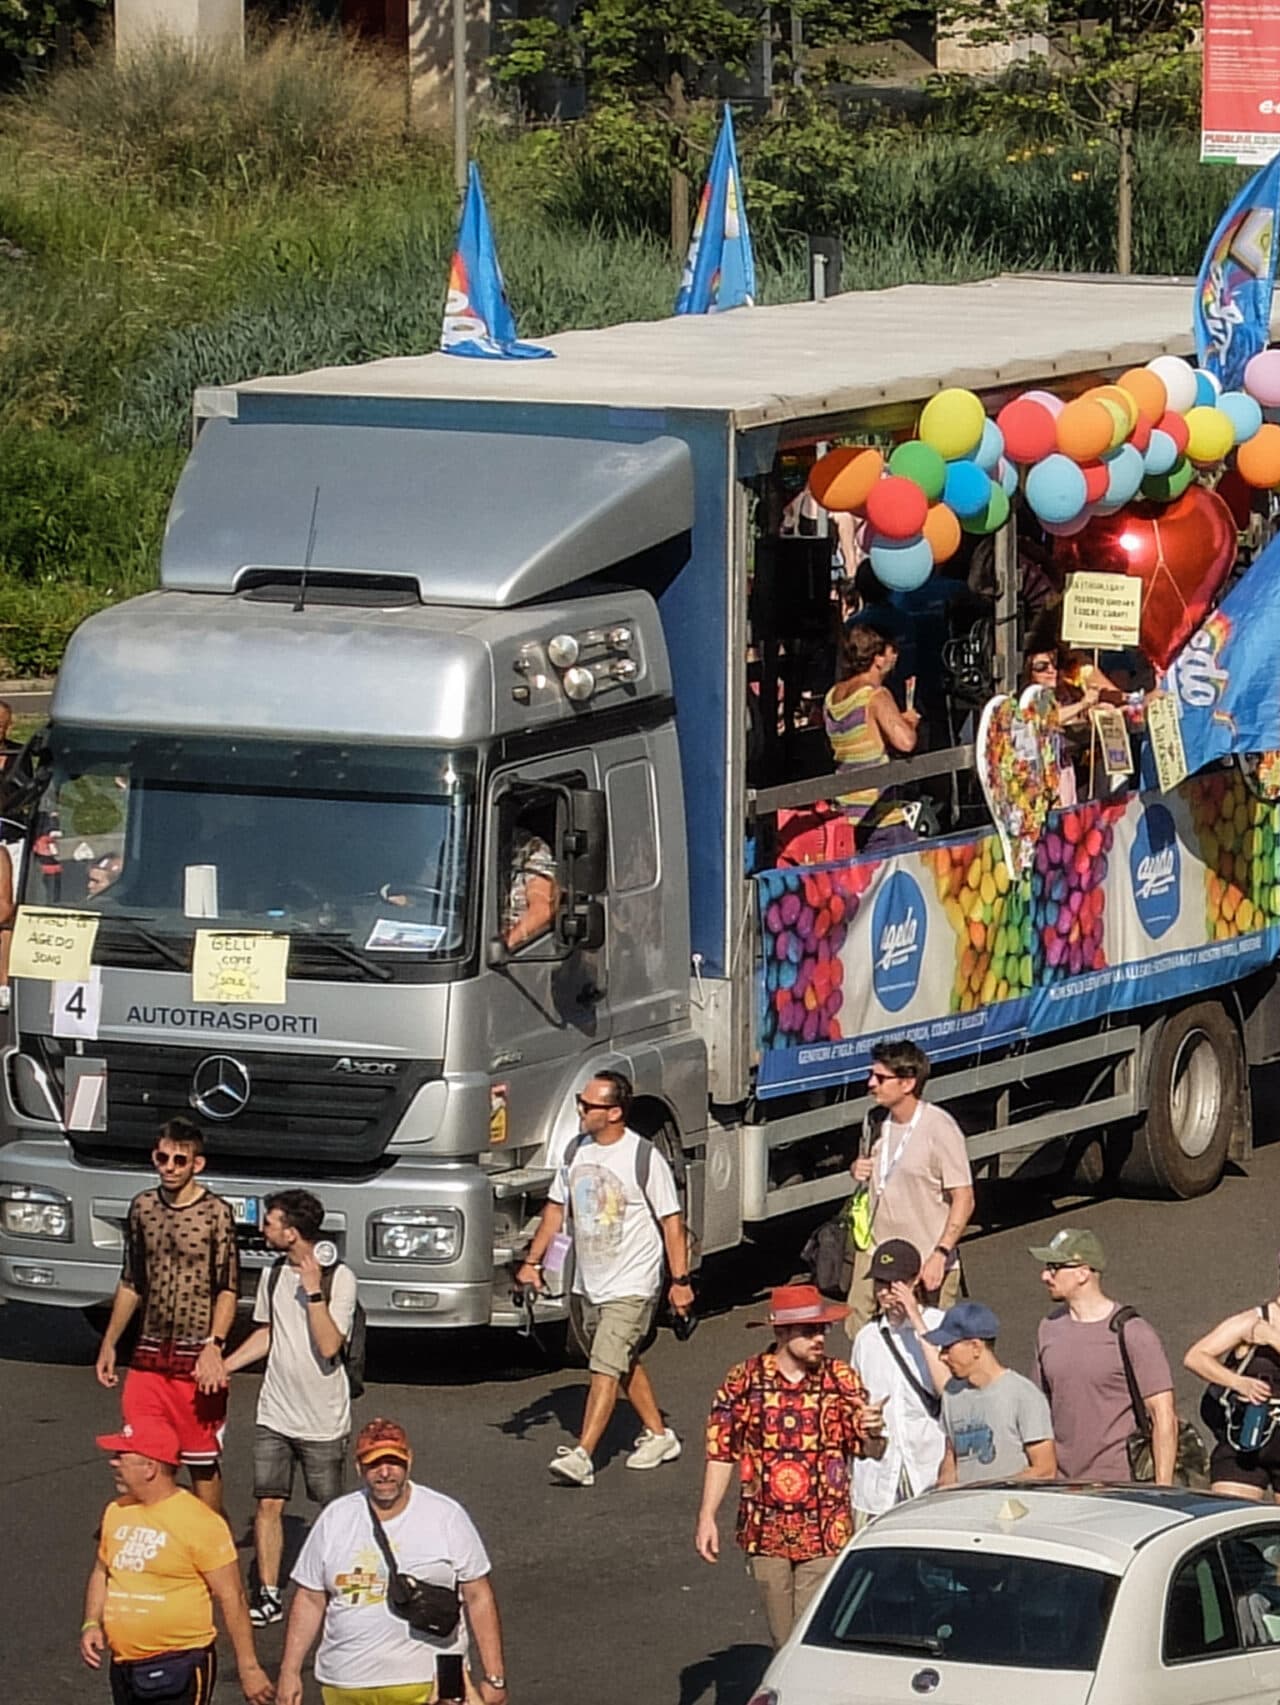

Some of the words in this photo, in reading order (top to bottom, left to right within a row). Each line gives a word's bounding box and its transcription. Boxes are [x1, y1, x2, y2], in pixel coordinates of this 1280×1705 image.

[27, 931, 75, 950] AGEDO
[211, 936, 257, 951] BELLI
[65, 986, 86, 1020] 4
[126, 1005, 318, 1034] AUTOTRASPORTI
